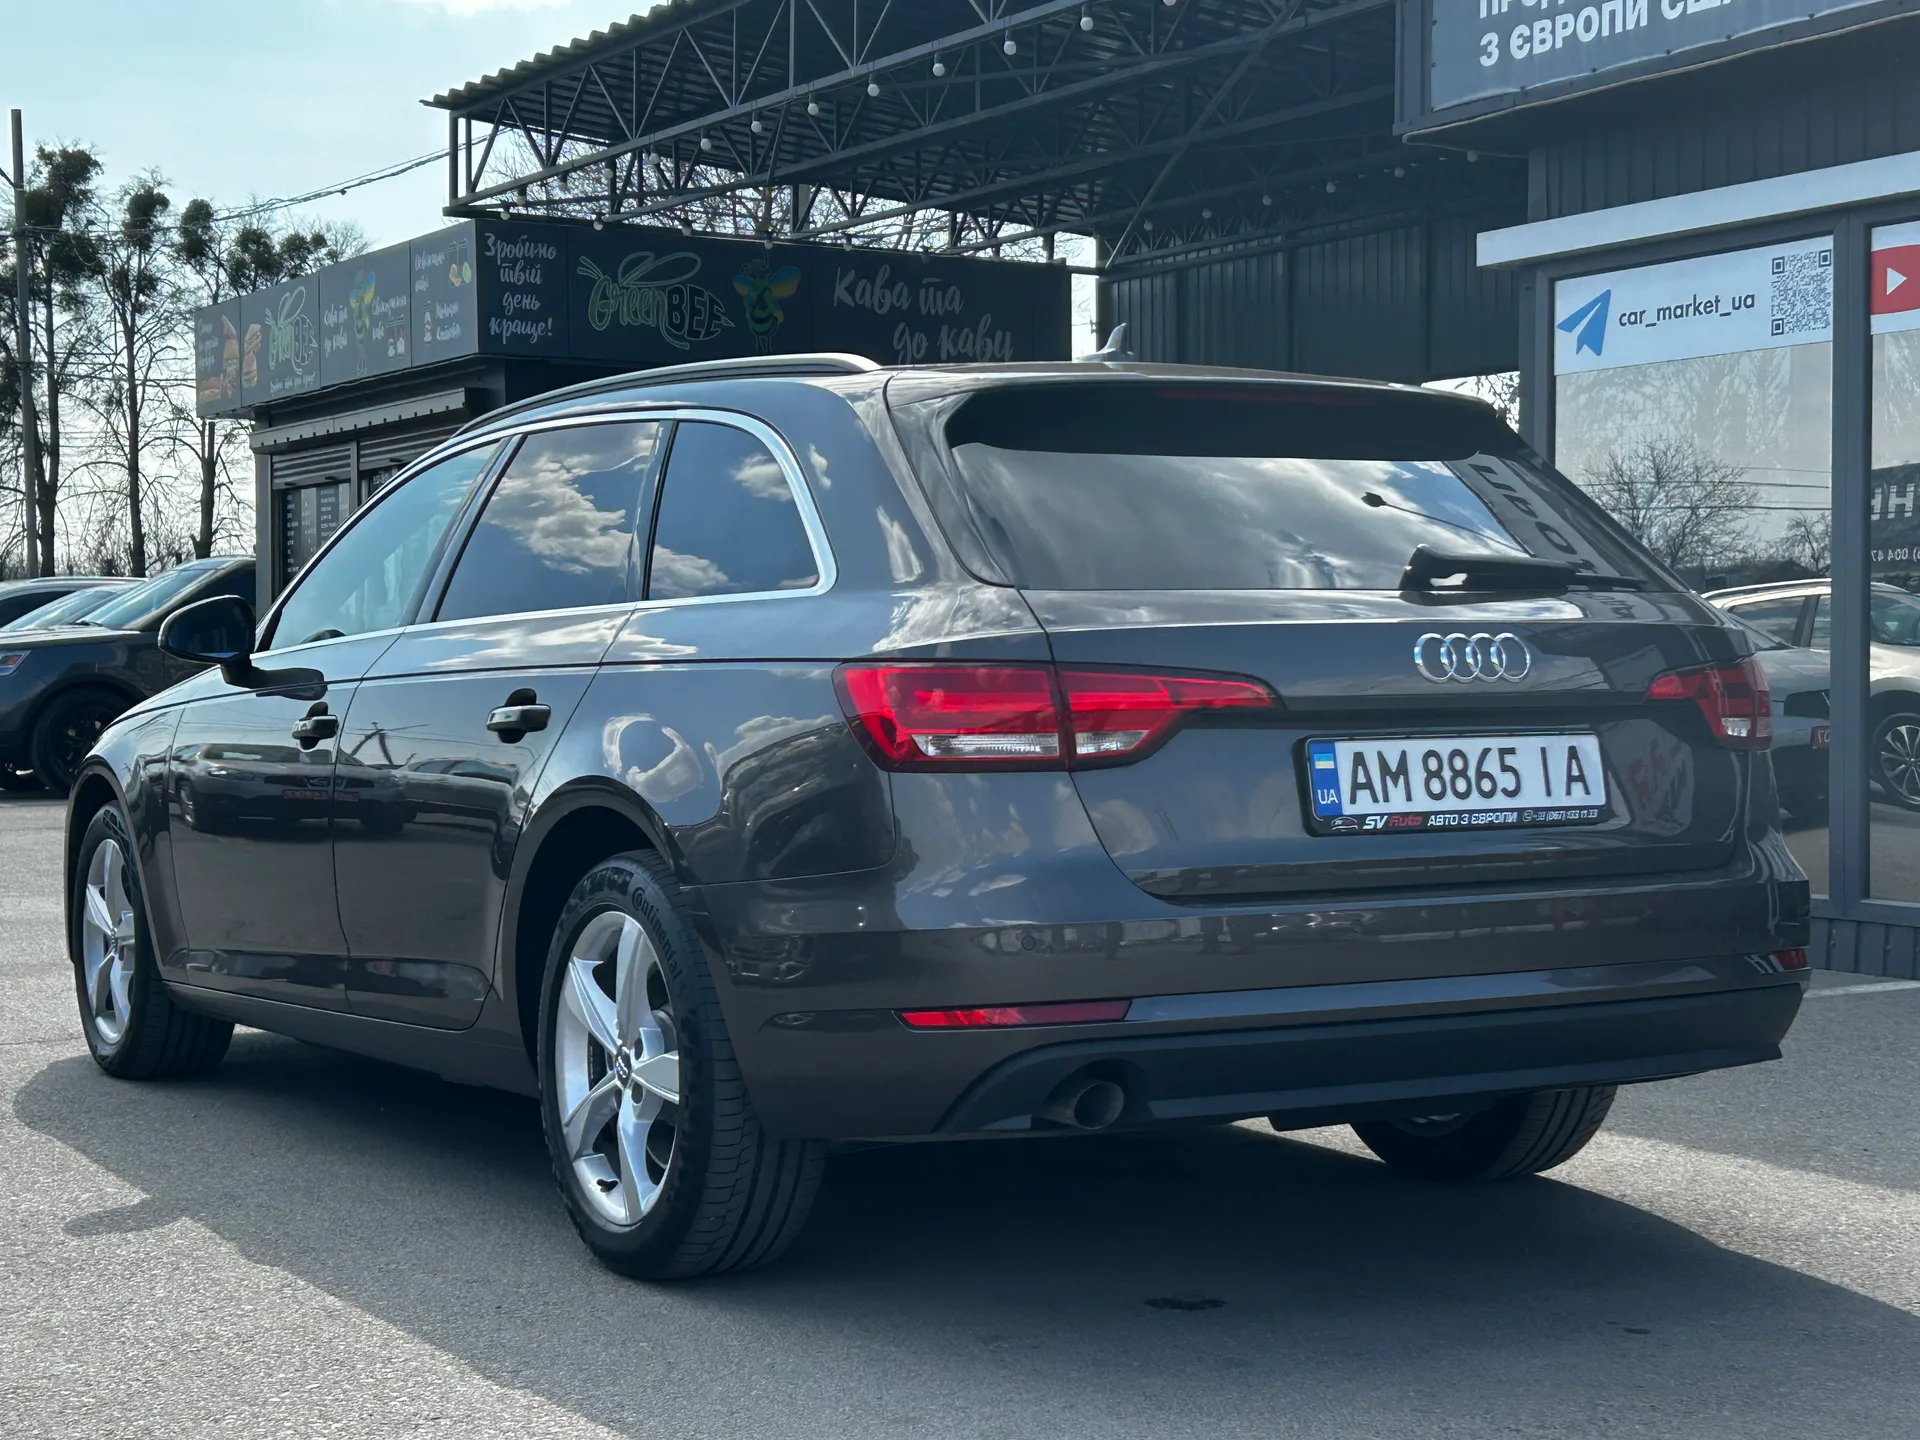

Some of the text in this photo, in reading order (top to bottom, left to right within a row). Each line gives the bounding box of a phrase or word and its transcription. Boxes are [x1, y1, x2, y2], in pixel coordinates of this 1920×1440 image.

[1479, 32, 1499, 67] З
[1509, 0, 1648, 60] ЄВРОПИ
[484, 232, 558, 265] Зробимо
[500, 259, 542, 285] твій
[502, 291, 541, 315] день
[833, 264, 964, 316] Кава та
[1618, 292, 1756, 328] car_market_ua
[489, 317, 553, 344] краще!
[892, 313, 1014, 364] до кави
[1349, 750, 1412, 805] AM
[1421, 747, 1521, 801] 8865
[1317, 788, 1339, 805] UA
[1362, 815, 1388, 830] SV
[1427, 814, 1459, 826] АВТО
